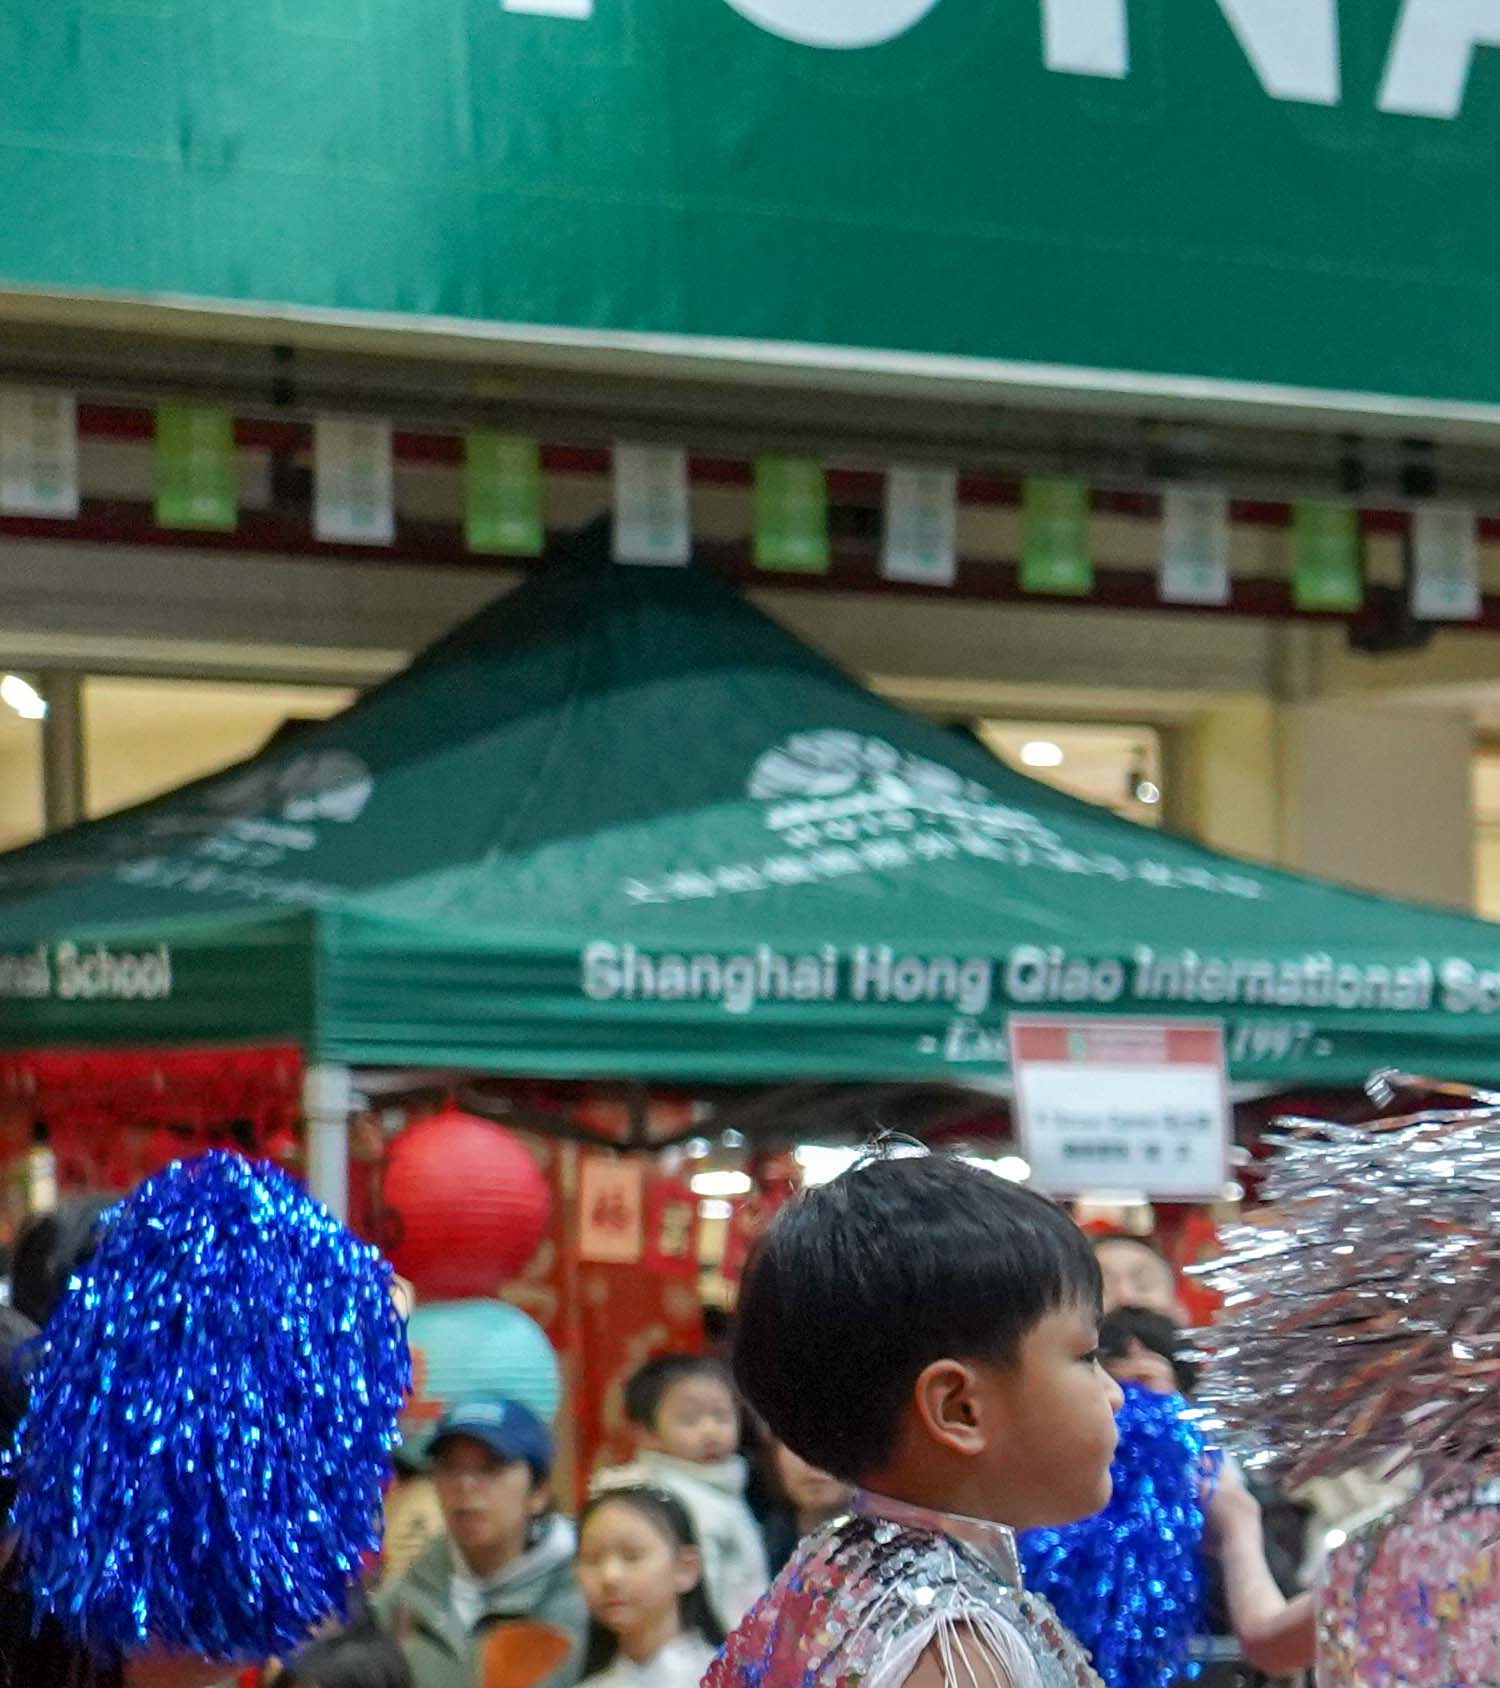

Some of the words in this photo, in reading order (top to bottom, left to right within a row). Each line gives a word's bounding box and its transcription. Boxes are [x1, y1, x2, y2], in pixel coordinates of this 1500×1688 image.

[582, 940, 838, 1015] Shanghai
[850, 943, 992, 1015] Hong
[1006, 944, 1125, 1002] Qiao
[1133, 943, 1432, 1009] International
